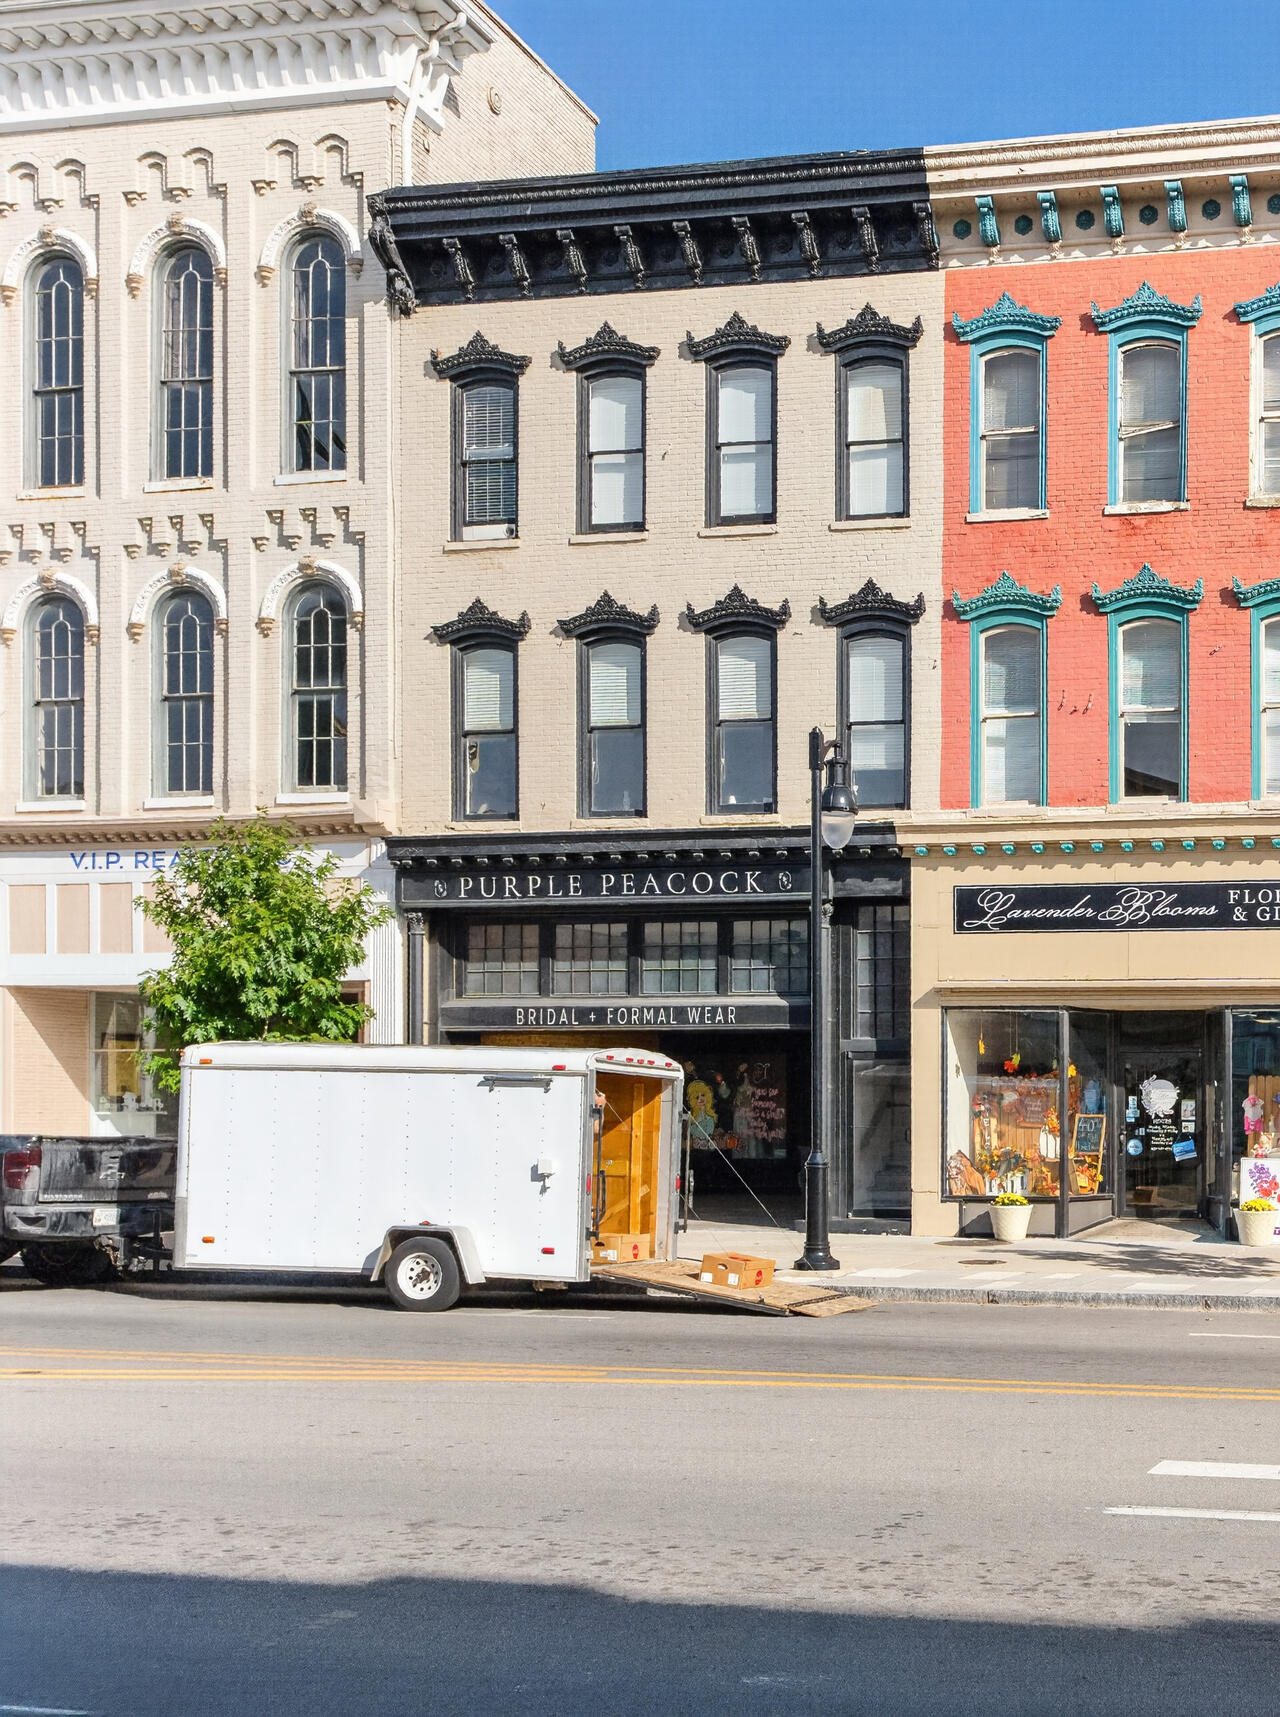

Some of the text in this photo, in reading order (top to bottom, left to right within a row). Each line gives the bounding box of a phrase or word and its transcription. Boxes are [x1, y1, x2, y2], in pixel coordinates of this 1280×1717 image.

[70, 851, 183, 870] V.I.P. REA
[458, 871, 764, 898] PURPLE PEACOCK
[964, 887, 1219, 931] Lavender Blooms
[1233, 906, 1248, 921] &
[516, 1008, 579, 1025] BRIDAL
[607, 1007, 677, 1024] FORMAL
[687, 1006, 737, 1023] WEAR
